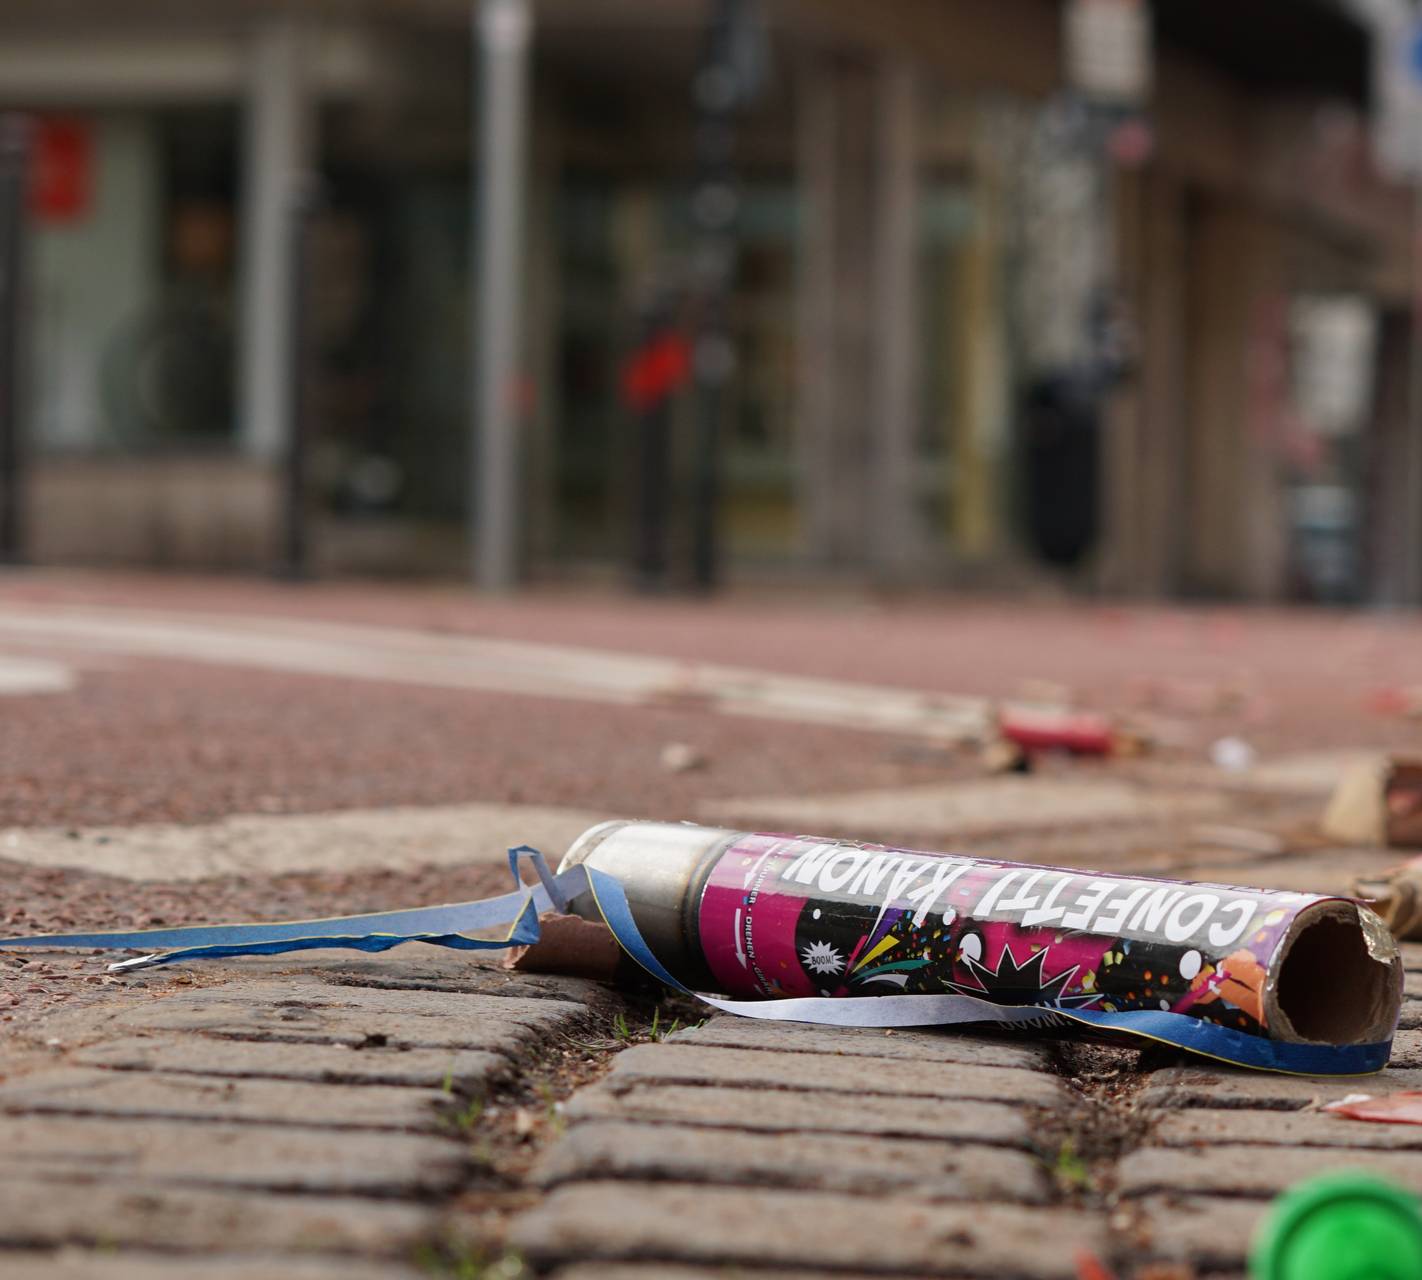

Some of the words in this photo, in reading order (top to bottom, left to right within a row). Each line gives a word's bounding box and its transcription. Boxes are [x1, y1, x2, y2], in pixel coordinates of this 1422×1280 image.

[782, 844, 972, 928] KANON
[973, 871, 1257, 946] CONFETTI
[745, 916, 756, 959] DREHEN
[811, 955, 835, 965] BOOM!
